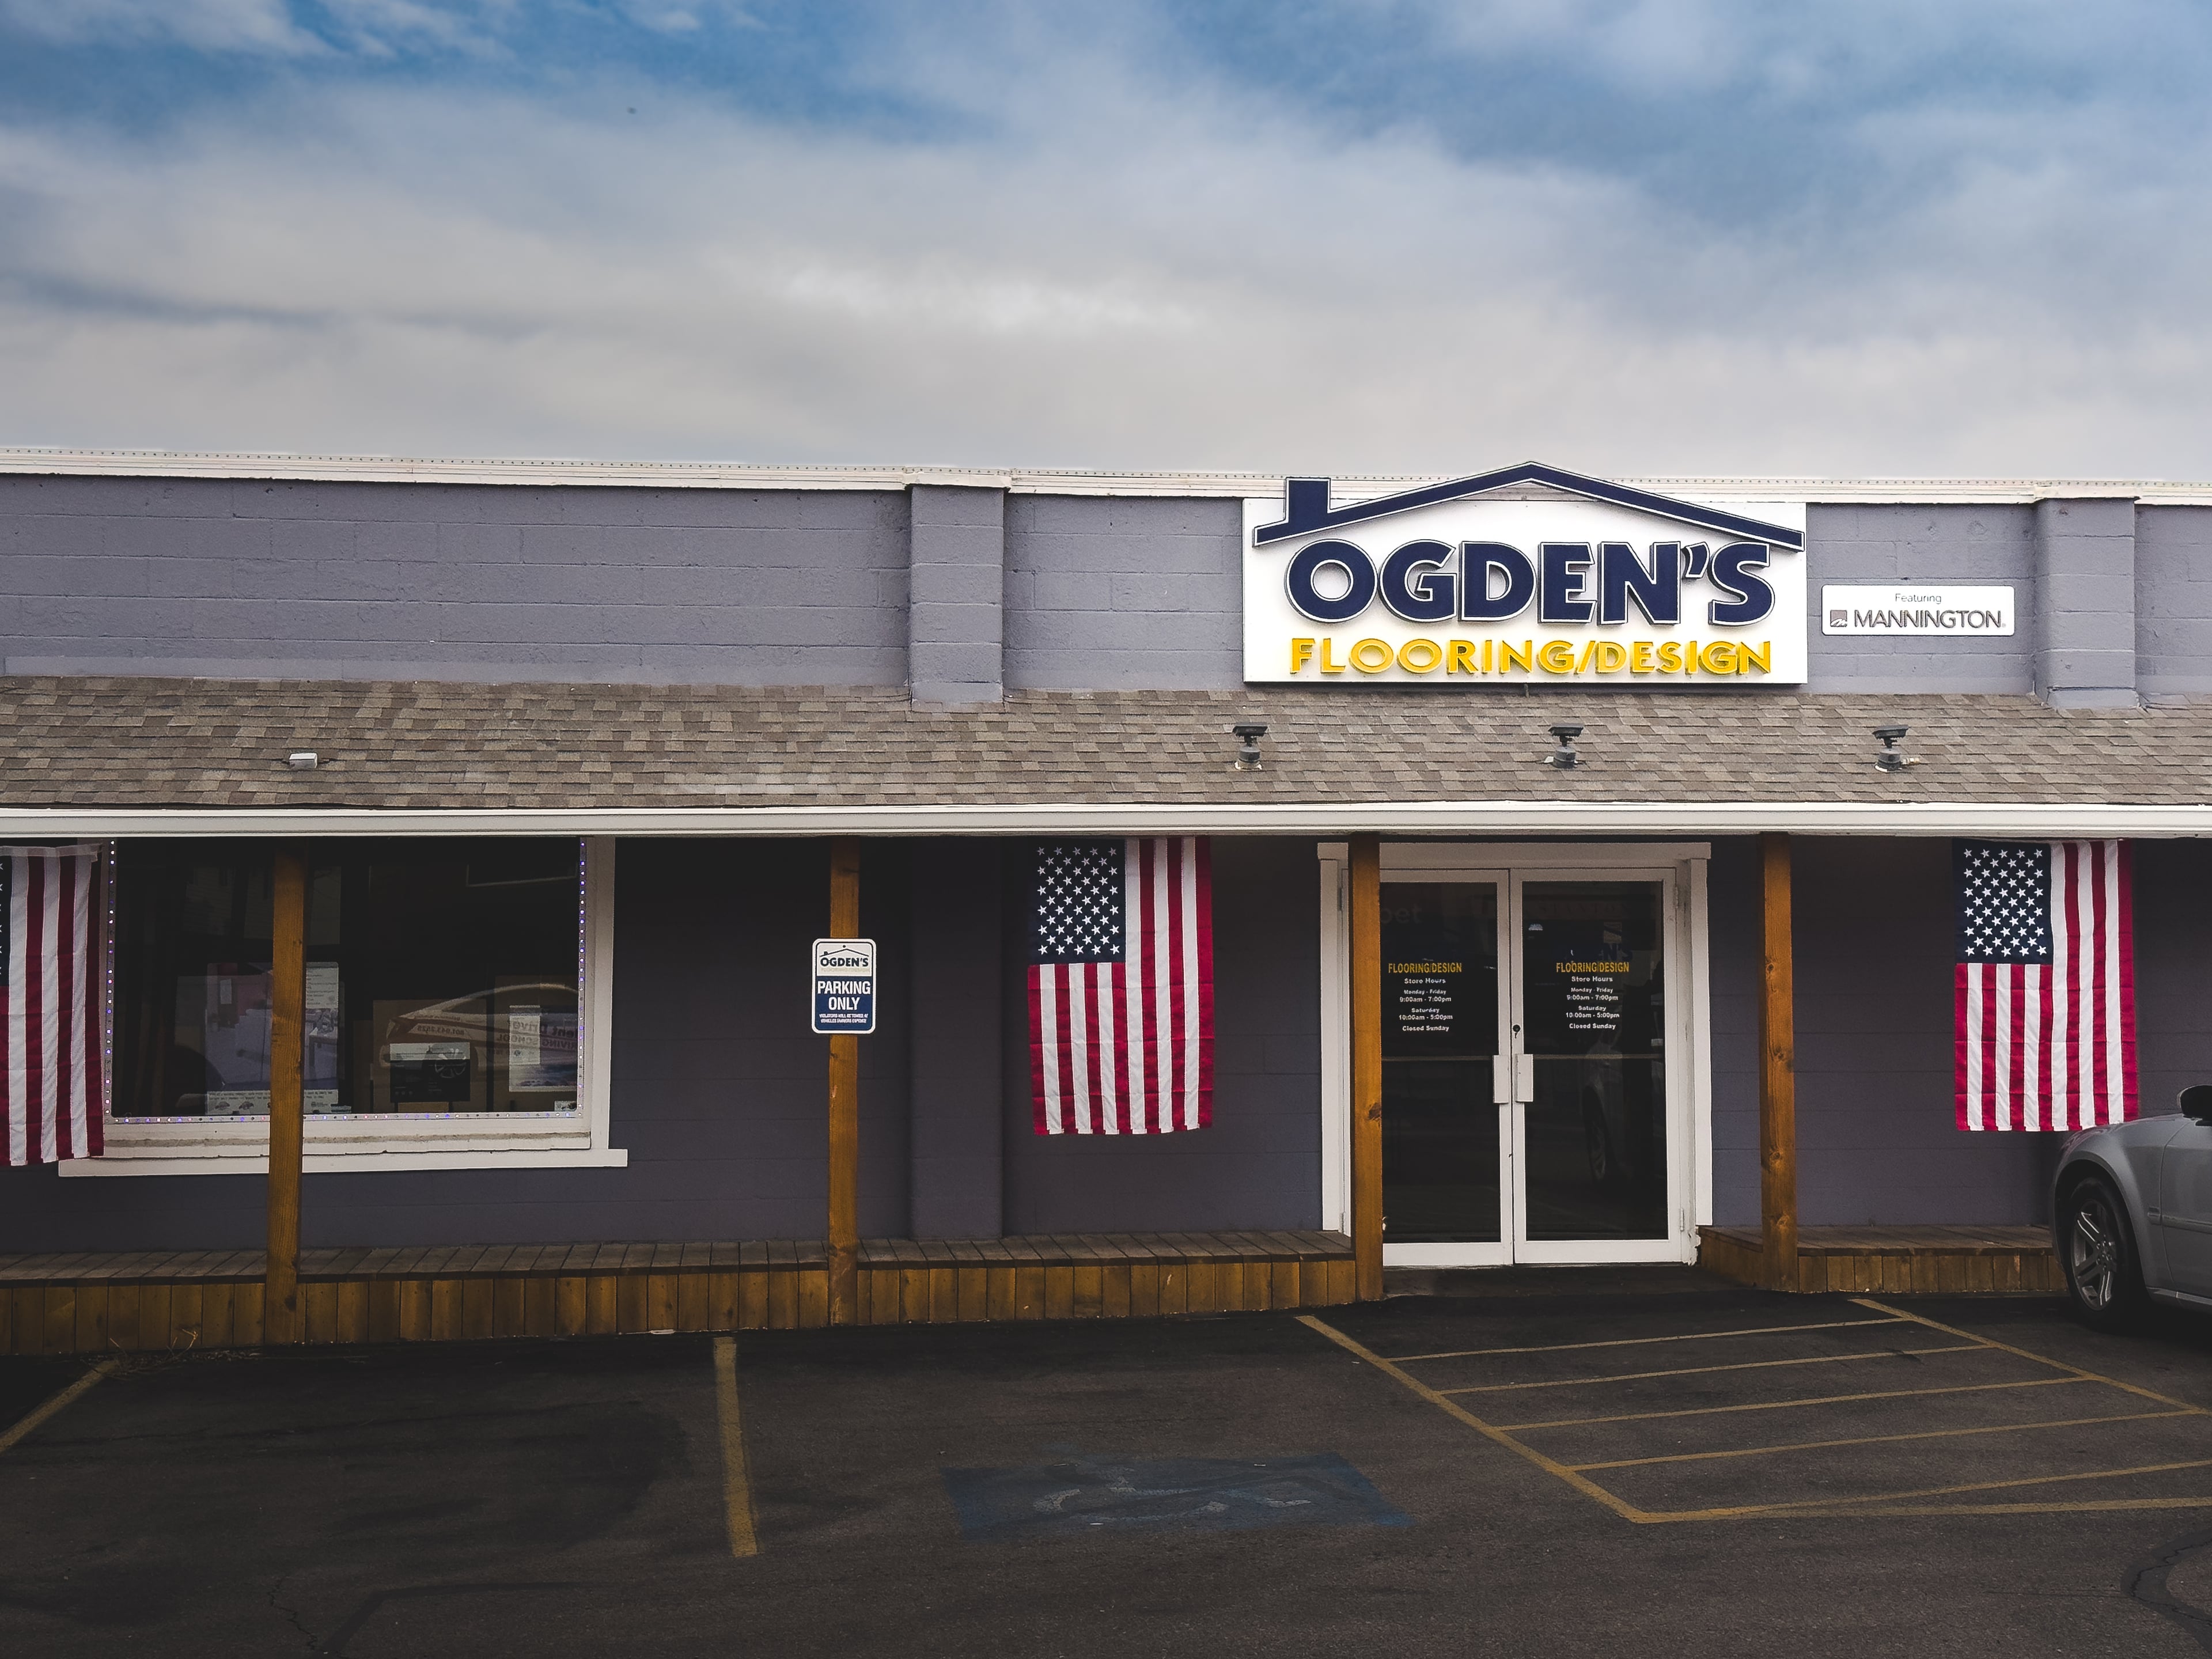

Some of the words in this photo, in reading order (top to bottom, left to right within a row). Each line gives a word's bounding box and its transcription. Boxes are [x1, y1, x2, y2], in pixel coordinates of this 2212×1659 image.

[1284, 538, 1775, 626] OGDEN'S
[1895, 593, 1942, 604] Featuring
[1854, 609, 2001, 628] MANNINGTON
[1289, 637, 1772, 675] FLOORING/DESIGN
[820, 957, 869, 967] OGDEN'S
[1388, 963, 1462, 973] FLOORING/DESIGN
[1556, 962, 1630, 972] FLOORING/DESIGN
[817, 981, 870, 995] PARKING
[828, 997, 860, 1010] ONLY
